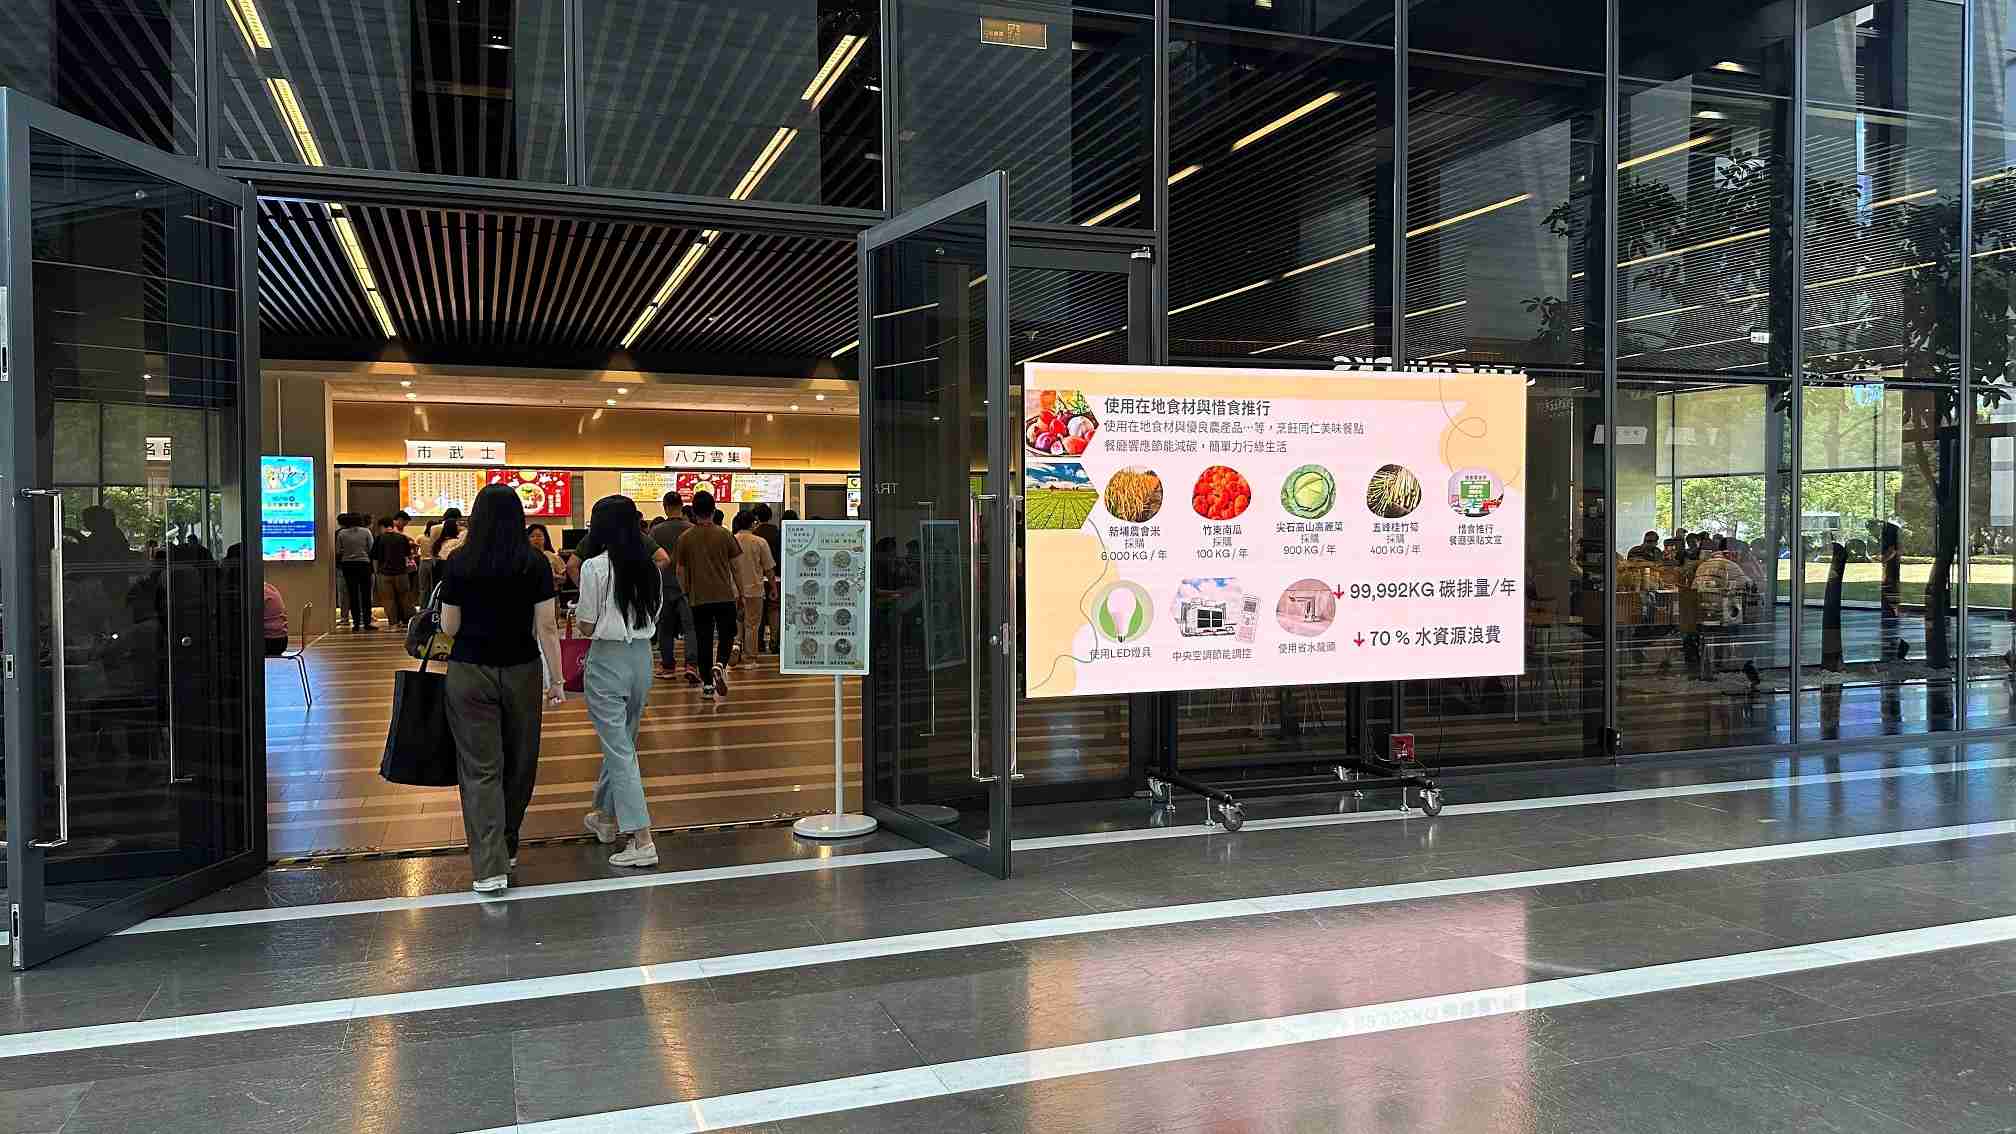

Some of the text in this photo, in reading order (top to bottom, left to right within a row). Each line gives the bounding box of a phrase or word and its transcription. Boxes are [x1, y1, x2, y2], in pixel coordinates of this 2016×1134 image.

[1104, 398, 1271, 416] 使用在地食材與惜食推行
[1203, 525, 1242, 536] 竹東南瓜
[1197, 549, 1213, 559] 100
[1215, 549, 1231, 558] KG
[1238, 548, 1249, 559] 年
[1283, 545, 1301, 555] 900
[1304, 545, 1319, 554] KG
[1327, 544, 1337, 555] 年
[1390, 545, 1404, 554] KG
[1411, 543, 1421, 554] 年
[1132, 551, 1148, 560] KG
[1158, 549, 1168, 560] 年
[1350, 578, 1516, 601] 99,992KG 碳排量/年
[1369, 625, 1501, 646] 70 % 水資源浪費
